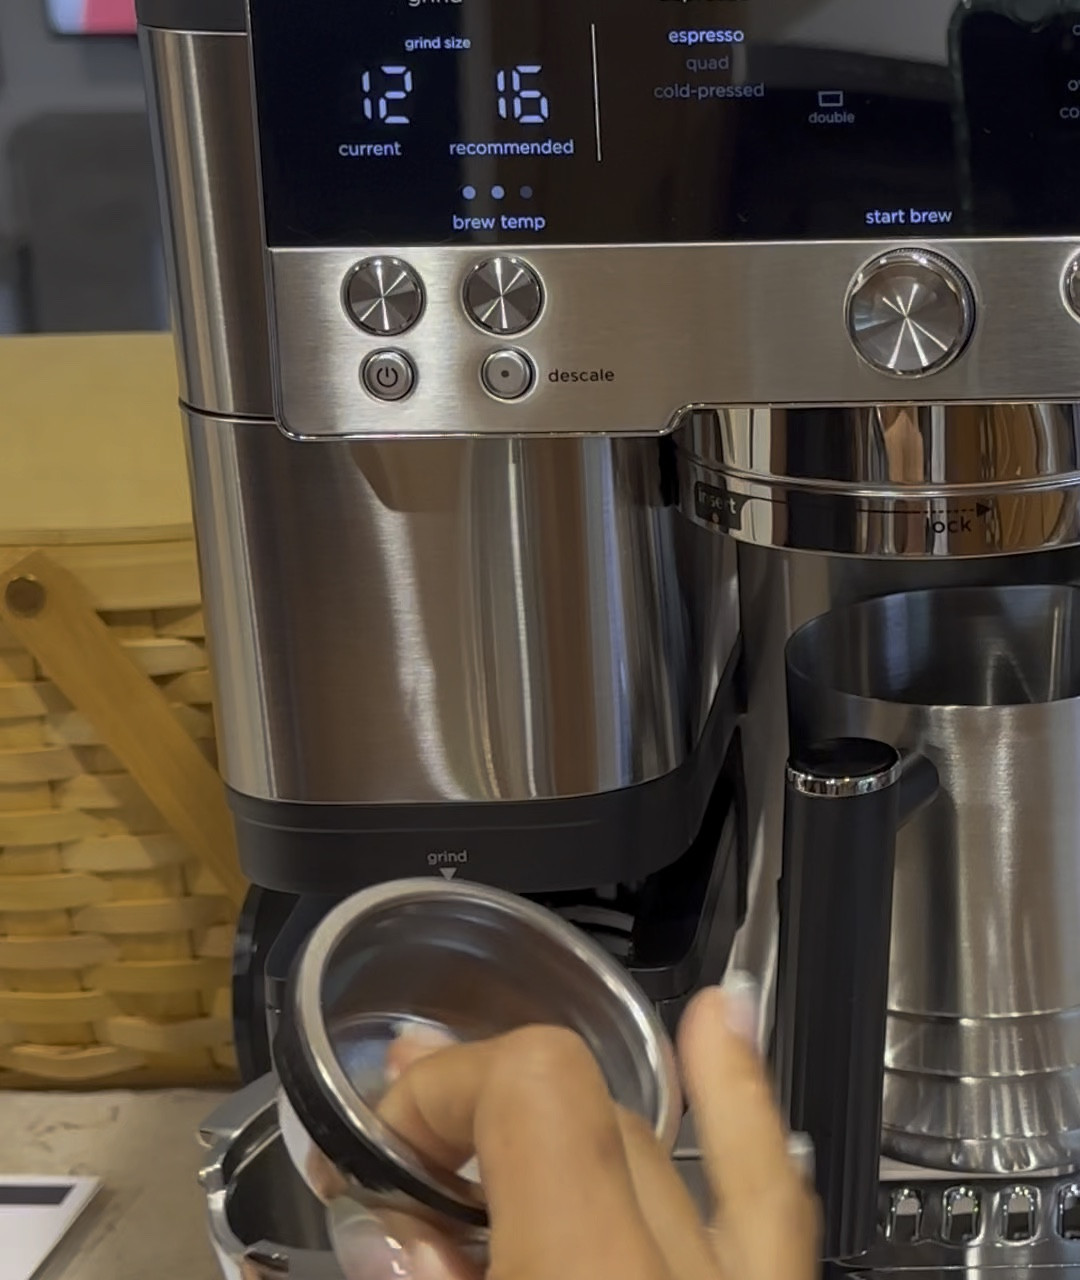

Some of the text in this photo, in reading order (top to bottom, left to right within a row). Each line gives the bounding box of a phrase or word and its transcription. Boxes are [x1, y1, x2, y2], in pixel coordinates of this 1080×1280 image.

[404, 35, 472, 52] grind size
[668, 28, 745, 45] espresso
[686, 54, 730, 73] quad
[362, 65, 413, 124] 12
[496, 65, 549, 124] 16
[653, 83, 765, 102] cold-pressed
[808, 111, 855, 125] double
[338, 141, 402, 157] current
[449, 139, 574, 156] recommended
[452, 215, 546, 233] brew temp
[866, 209, 952, 225] start brew
[548, 367, 615, 383] descale
[427, 849, 468, 866] grind
